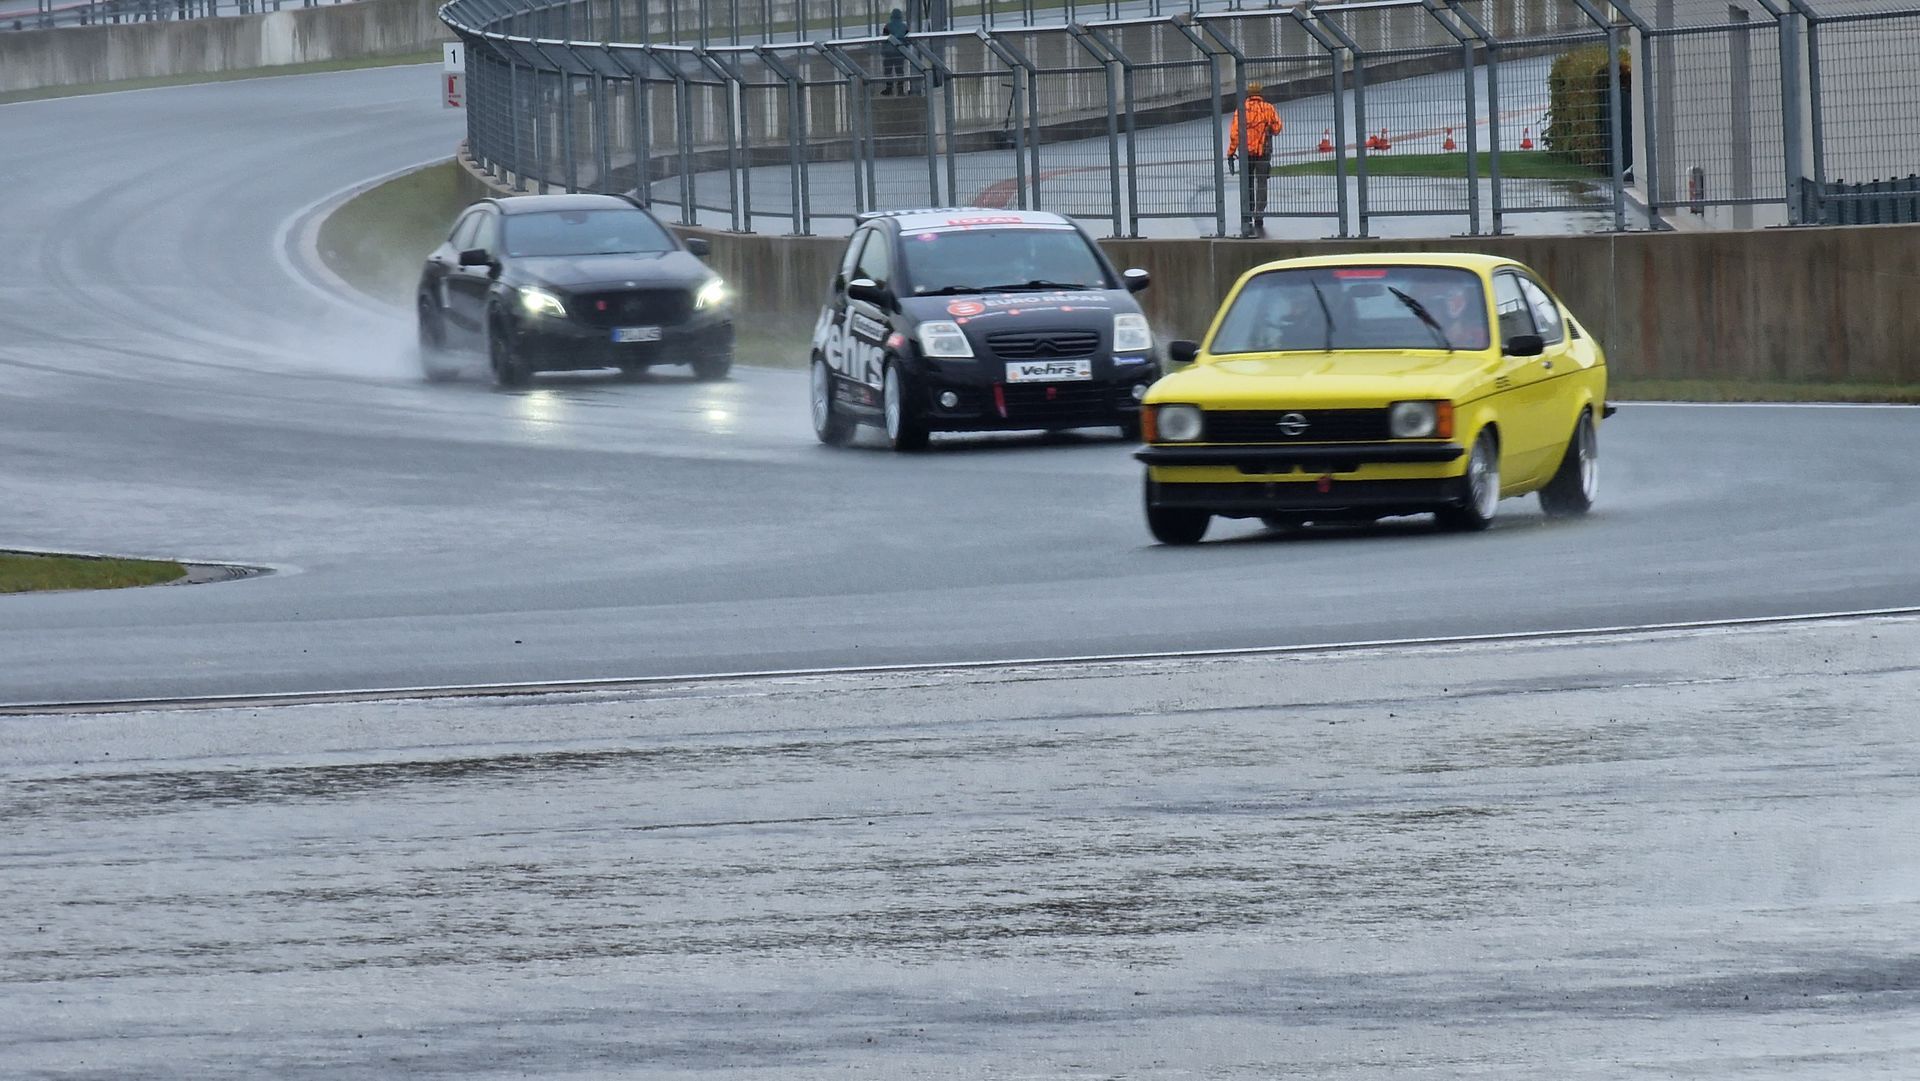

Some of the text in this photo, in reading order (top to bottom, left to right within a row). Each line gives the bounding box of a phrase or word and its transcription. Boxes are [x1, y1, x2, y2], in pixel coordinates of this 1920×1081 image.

[451, 49, 456, 64] 1
[984, 297, 1039, 306] EURO
[1021, 363, 1077, 376] Vehrs
